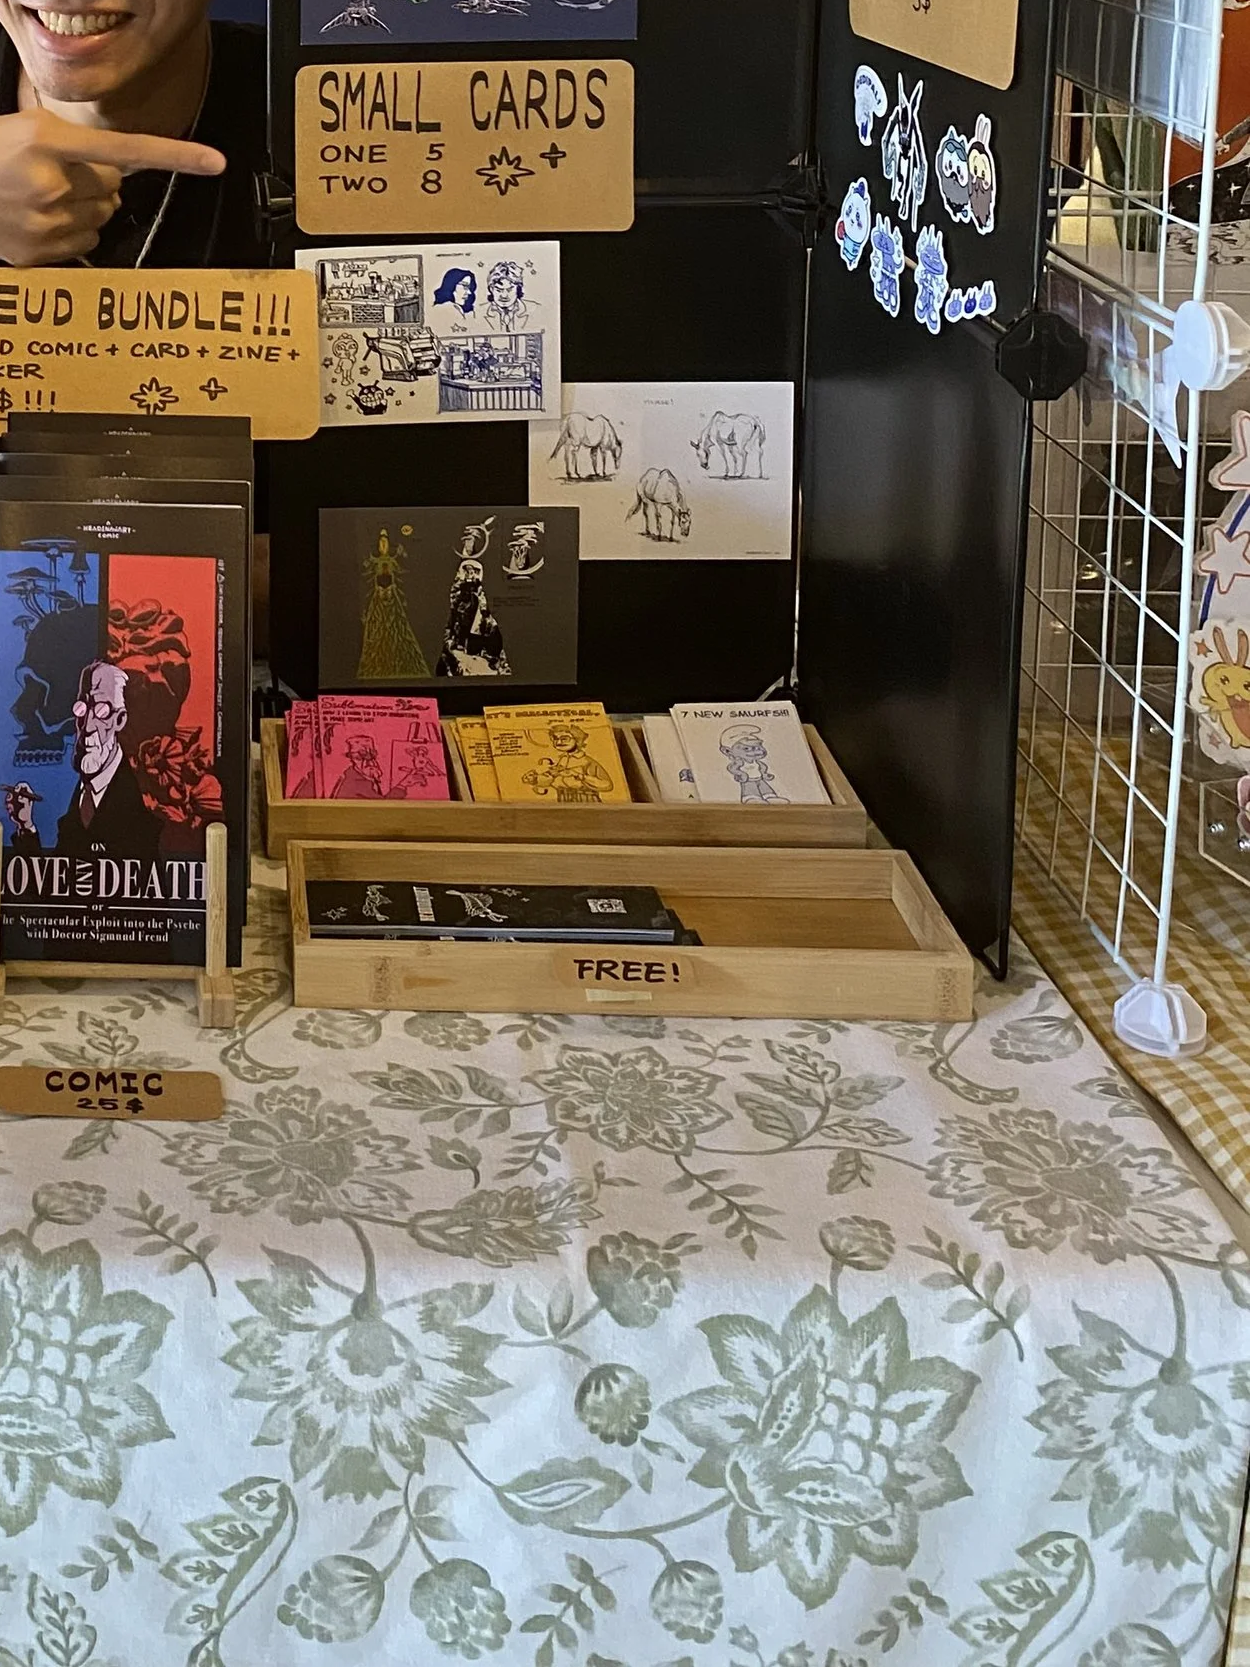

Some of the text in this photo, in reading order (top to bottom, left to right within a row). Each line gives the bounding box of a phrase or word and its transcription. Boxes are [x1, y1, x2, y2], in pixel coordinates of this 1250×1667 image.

[318, 68, 608, 134] SMALL CARDS
[319, 143, 445, 164] ONE 5
[319, 169, 443, 195] TWO 8
[97, 287, 292, 337] BUNDLE!!!
[27, 341, 97, 358] COMIC
[130, 342, 191, 360] CARD
[218, 345, 284, 363] ZINE
[91, 842, 106, 852] ON
[0, 855, 206, 901] OVE AND DEATH
[92, 903, 104, 911] or
[19, 915, 80, 928] Spectacular
[83, 916, 120, 929] Exploit
[123, 917, 145, 928] into
[147, 917, 164, 928] the
[166, 919, 201, 933] Psyche
[27, 930, 169, 944] with Doctor Sigmund Freud
[573, 959, 680, 983] FREE!
[45, 1070, 164, 1096] COMIC
[74, 1096, 144, 1114] 25$
